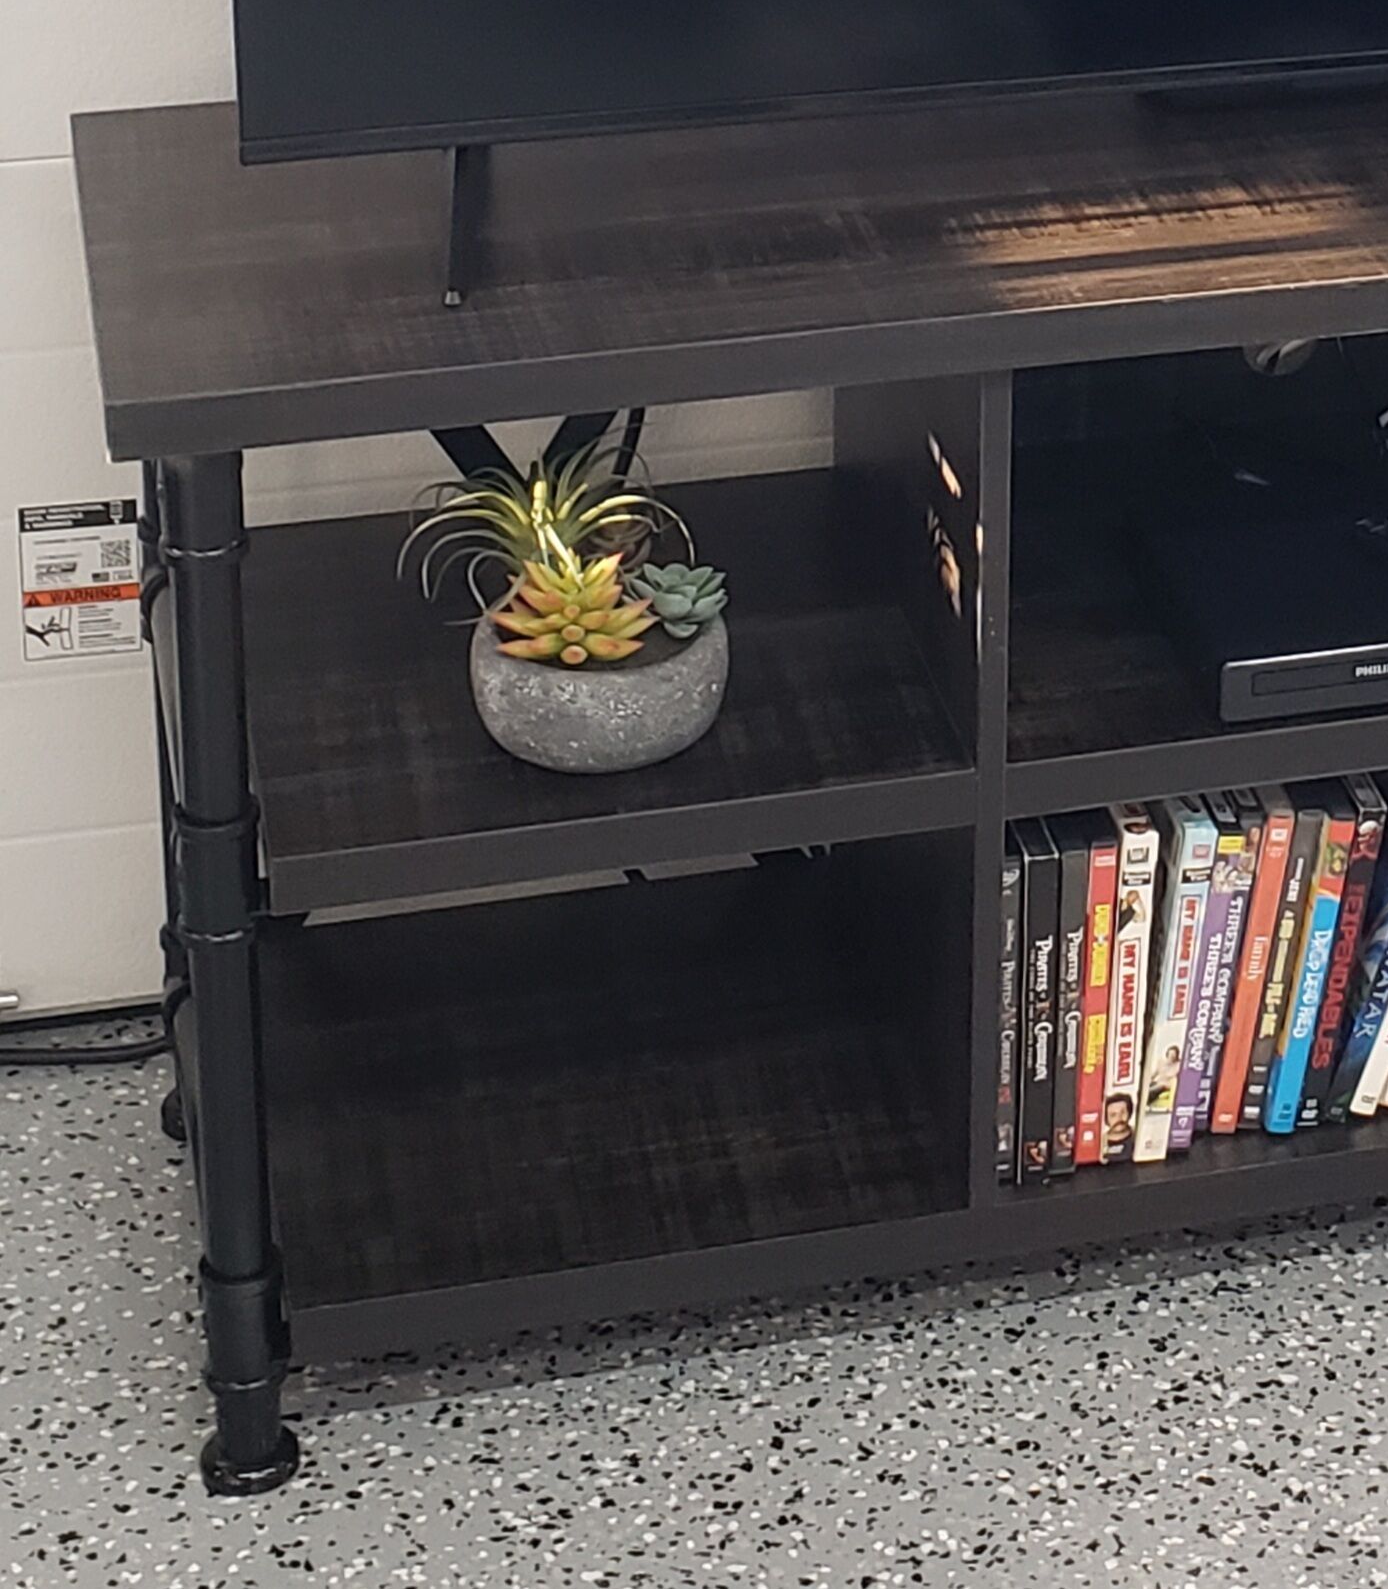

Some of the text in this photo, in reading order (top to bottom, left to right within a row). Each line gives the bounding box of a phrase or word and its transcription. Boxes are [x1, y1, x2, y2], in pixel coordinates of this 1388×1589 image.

[51, 587, 122, 603] WARNING
[1184, 899, 1197, 920] MY
[1035, 935, 1053, 991] PIRATES
[1067, 926, 1083, 981] PIRATES
[1117, 944, 1136, 1081] MY NAME IS EARL
[1188, 1000, 1211, 1071] COMPANY
